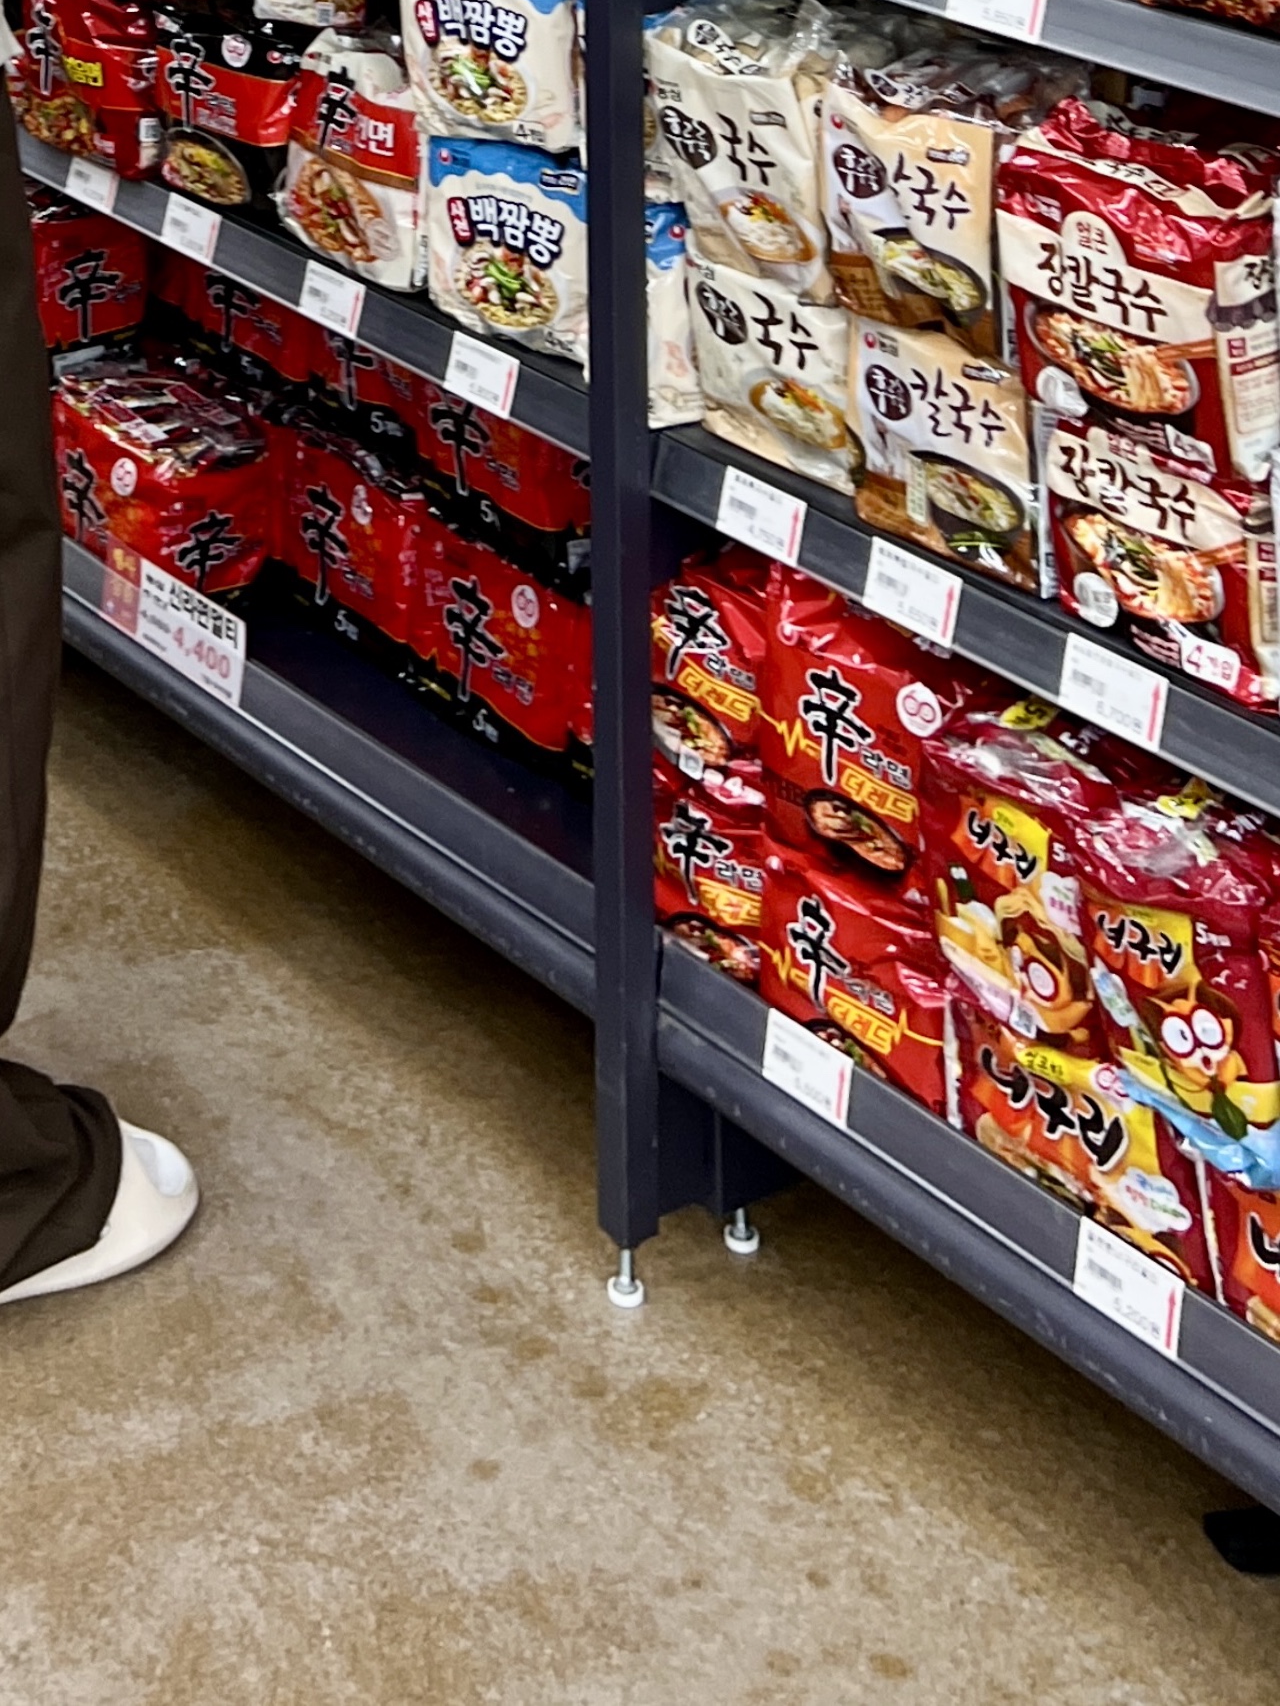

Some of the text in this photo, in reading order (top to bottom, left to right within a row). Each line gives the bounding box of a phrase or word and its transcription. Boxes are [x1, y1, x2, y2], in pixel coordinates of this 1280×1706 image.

[164, 32, 218, 132] 辛
[315, 65, 358, 150] 辛
[716, 111, 777, 186] 국수
[467, 196, 565, 263] 백짬뽕
[55, 248, 124, 343] 辛
[1037, 242, 1169, 334] 장칼국수
[750, 290, 819, 371] 국수
[909, 367, 1007, 449] 칼국수
[62, 446, 109, 542] 辛
[175, 509, 244, 592] 辛
[299, 481, 353, 607] 辛
[170, 626, 232, 681] 4,400
[443, 574, 509, 702] 辛
[663, 585, 731, 681] 辛
[703, 652, 757, 690] 라면
[677, 666, 756, 722] 더레드
[798, 665, 876, 786] 辛
[840, 768, 915, 823] 더레드
[859, 745, 913, 789] 라면
[658, 797, 733, 906] 辛
[713, 860, 764, 892] 라면
[965, 809, 1038, 883] 너구리
[785, 893, 852, 1012] 辛
[1095, 910, 1184, 978] 너구리
[979, 1045, 1129, 1173] 너구리
